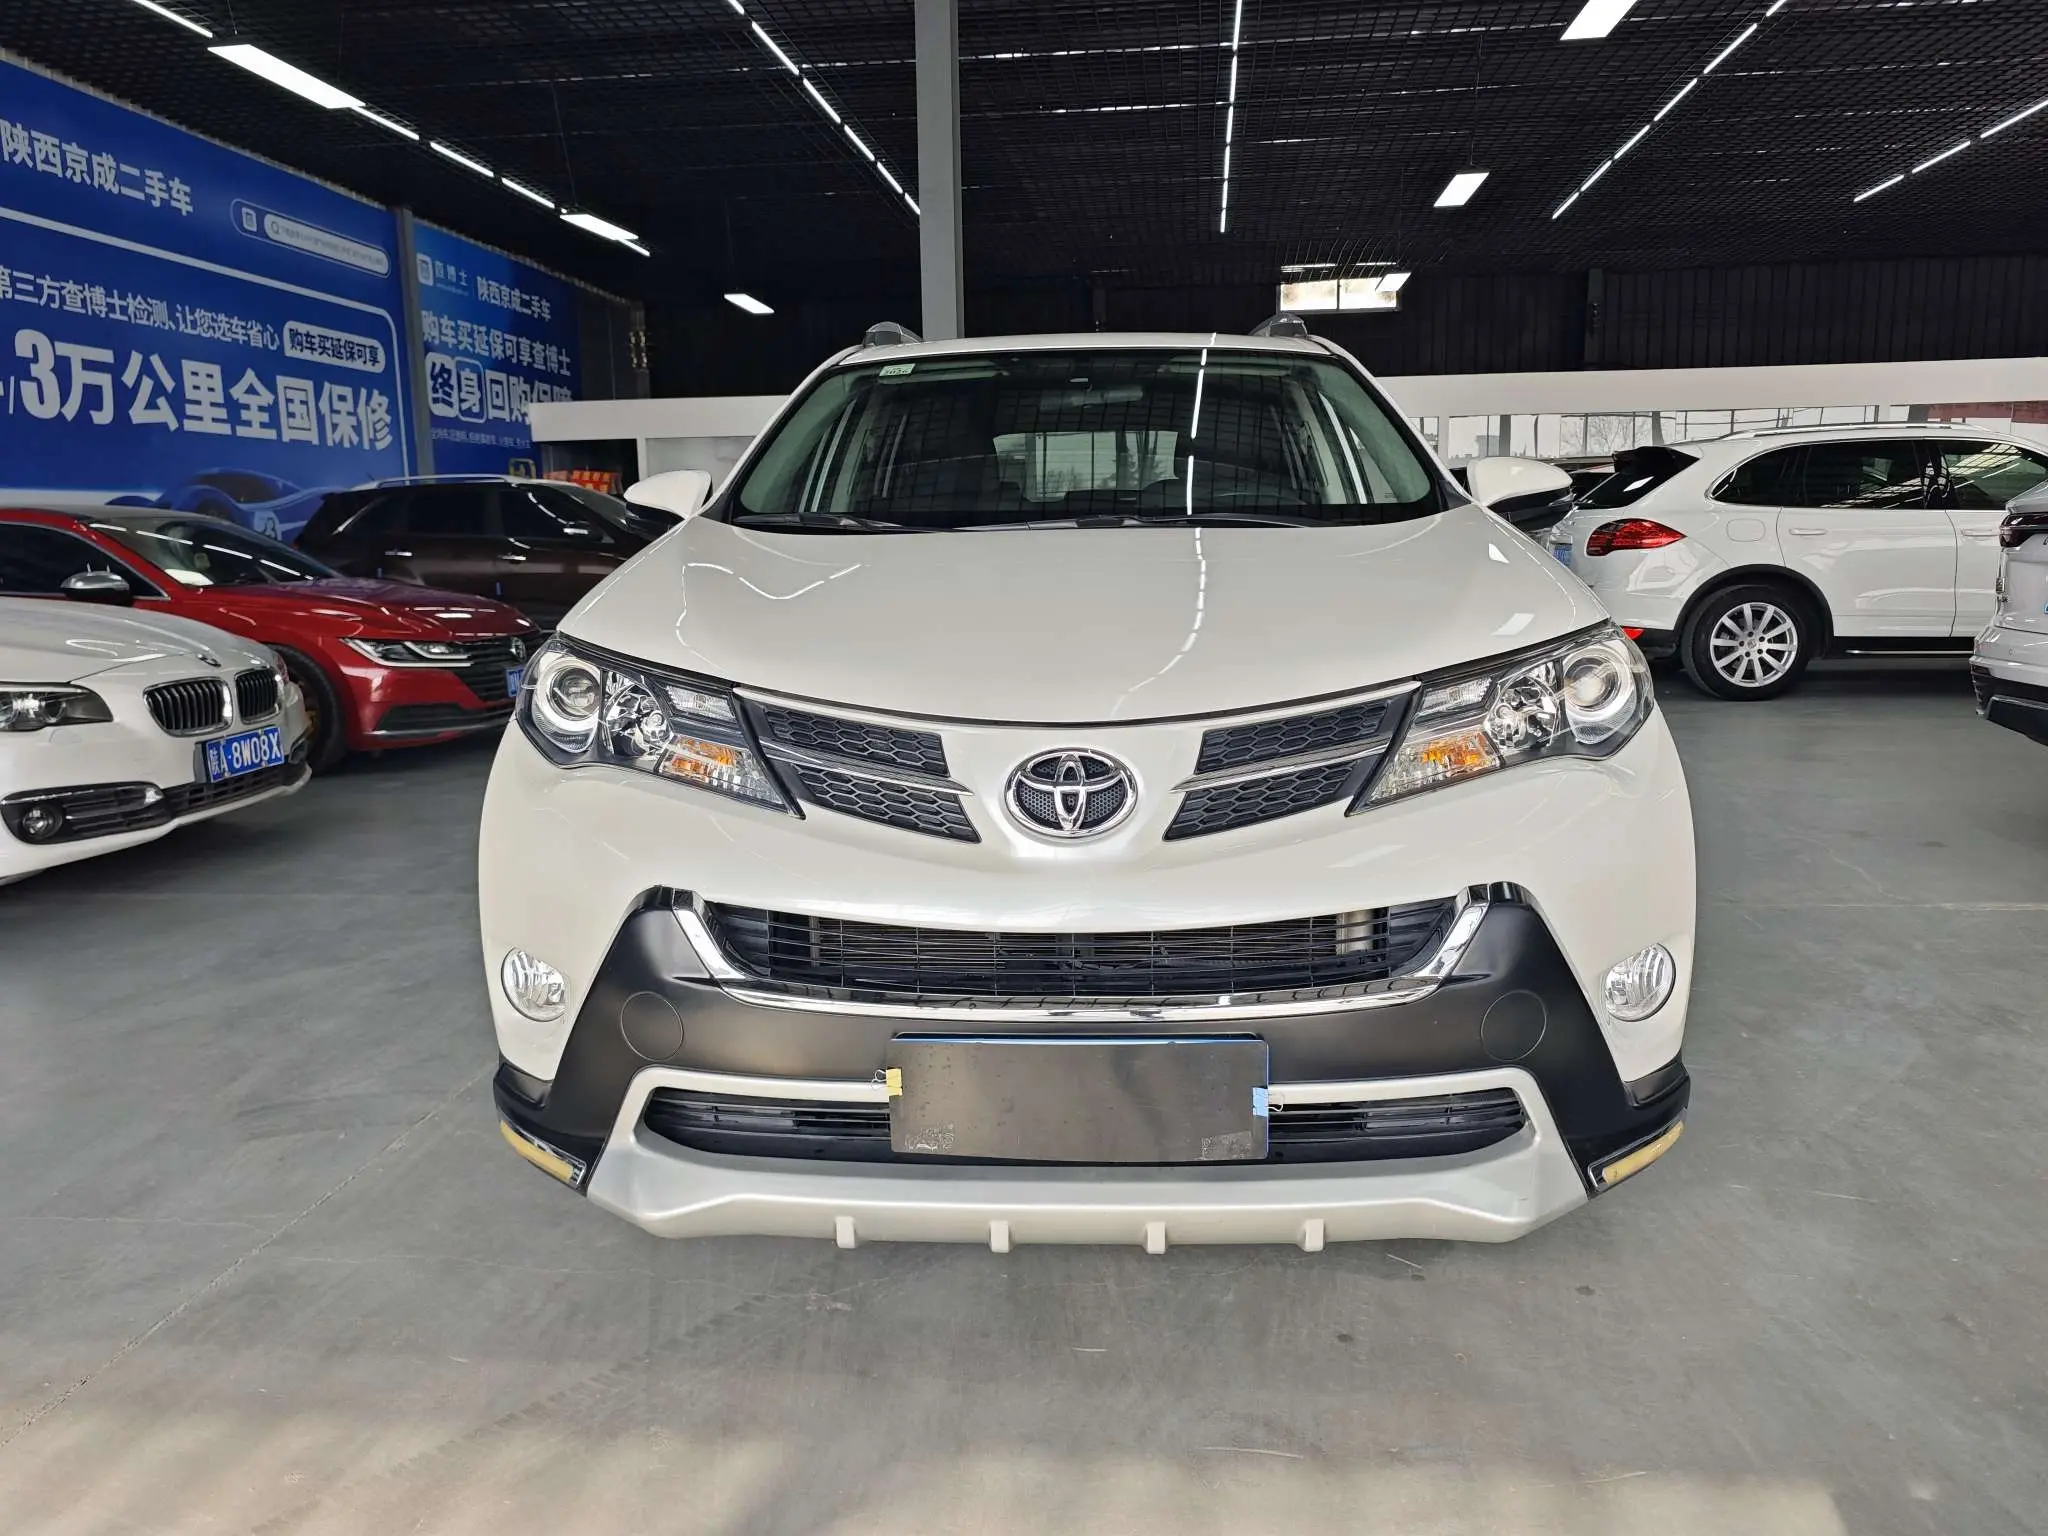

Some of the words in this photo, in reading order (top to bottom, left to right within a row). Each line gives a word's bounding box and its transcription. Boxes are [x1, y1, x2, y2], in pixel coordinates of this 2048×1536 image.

[0, 119, 194, 216] 陕西京成二手车
[476, 276, 552, 321] 陕西京成二手车
[288, 327, 381, 367] 购车买延保可享
[421, 310, 571, 377] 购车买延保可享查博士
